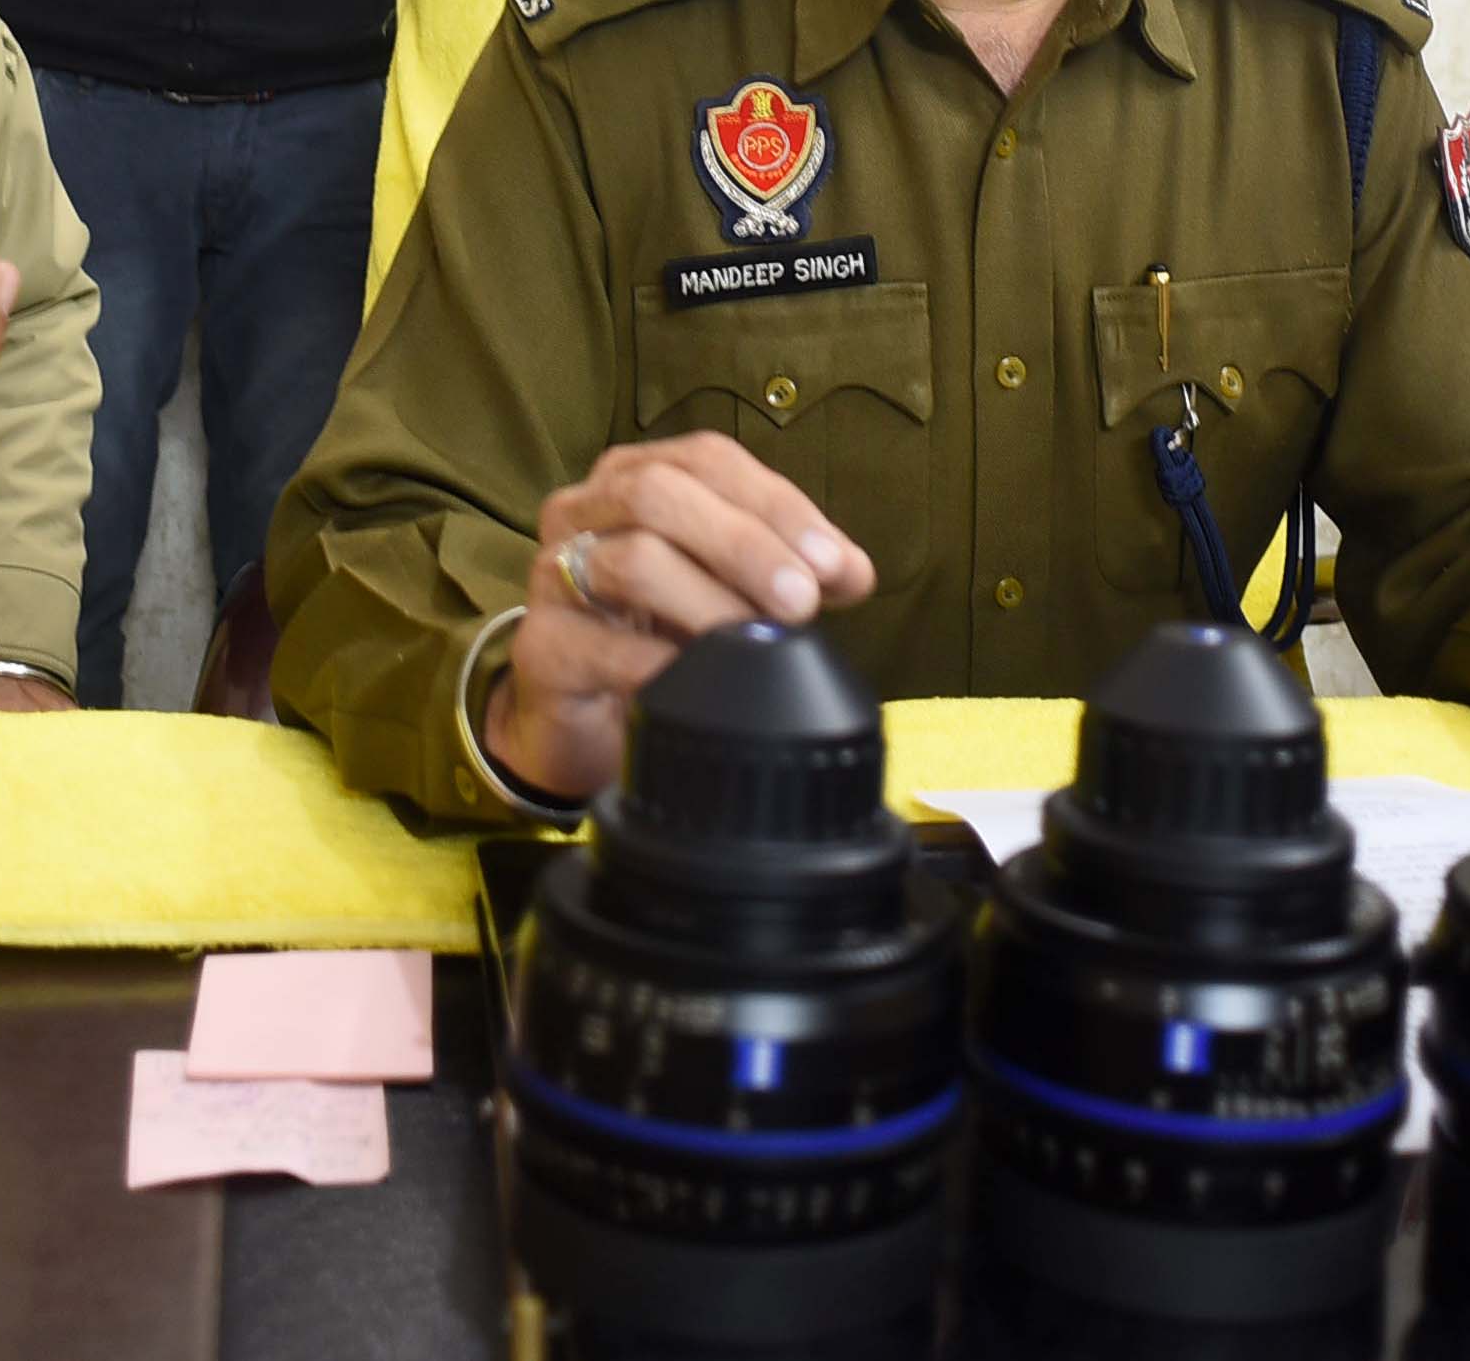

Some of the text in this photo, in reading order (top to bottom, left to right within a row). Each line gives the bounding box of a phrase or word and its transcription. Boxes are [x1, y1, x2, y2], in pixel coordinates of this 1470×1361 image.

[743, 135, 784, 159] PPS
[680, 251, 866, 297] MANDEEP SINGH
